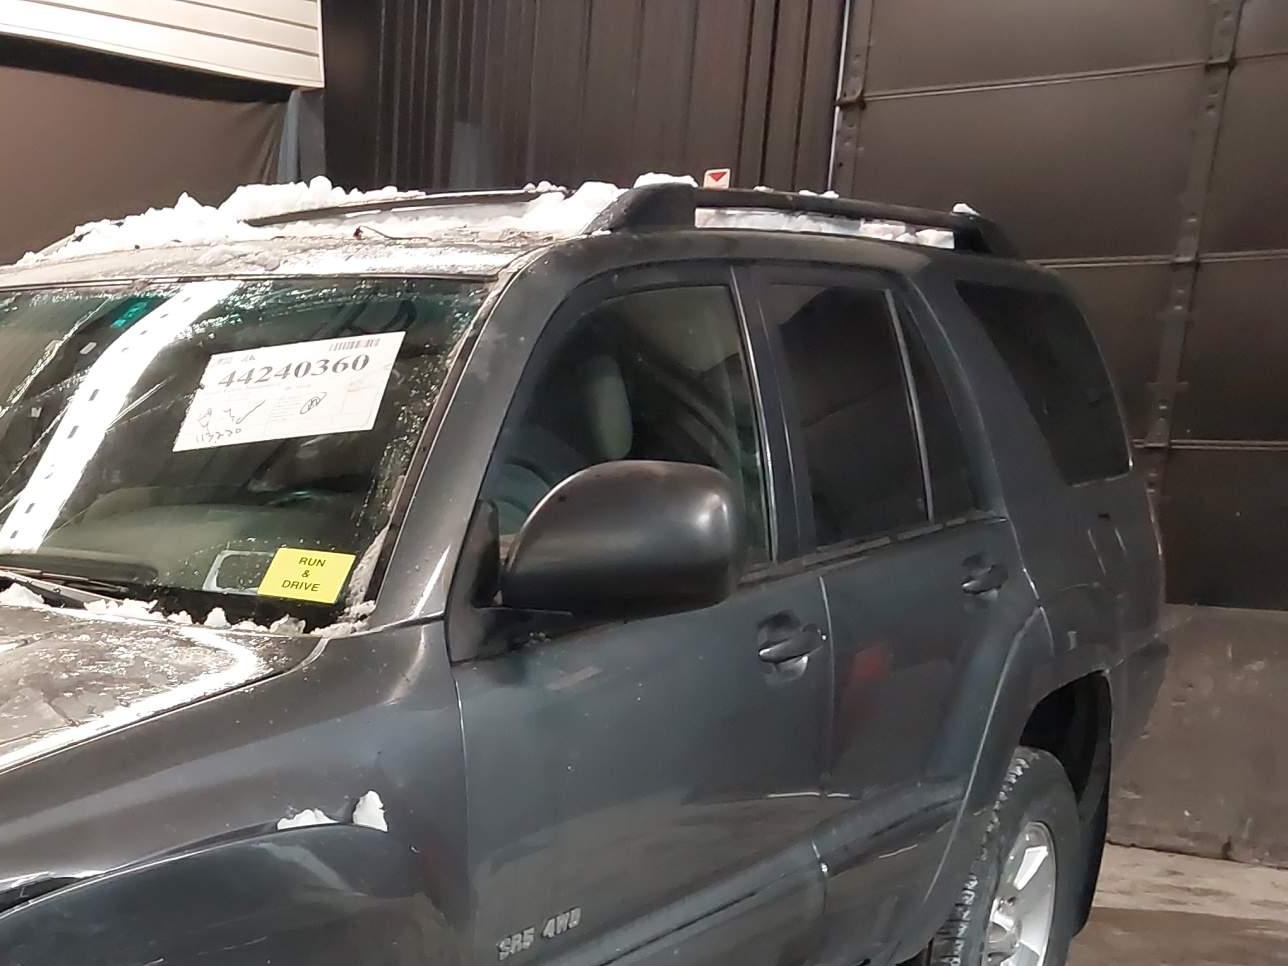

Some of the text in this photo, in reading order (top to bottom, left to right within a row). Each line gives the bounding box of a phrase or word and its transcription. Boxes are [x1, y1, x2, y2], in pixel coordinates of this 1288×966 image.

[217, 353, 370, 388] 44240360
[298, 557, 326, 568] RUN
[301, 569, 311, 578] &
[281, 579, 321, 592] DRIVE
[497, 927, 535, 960] SR5
